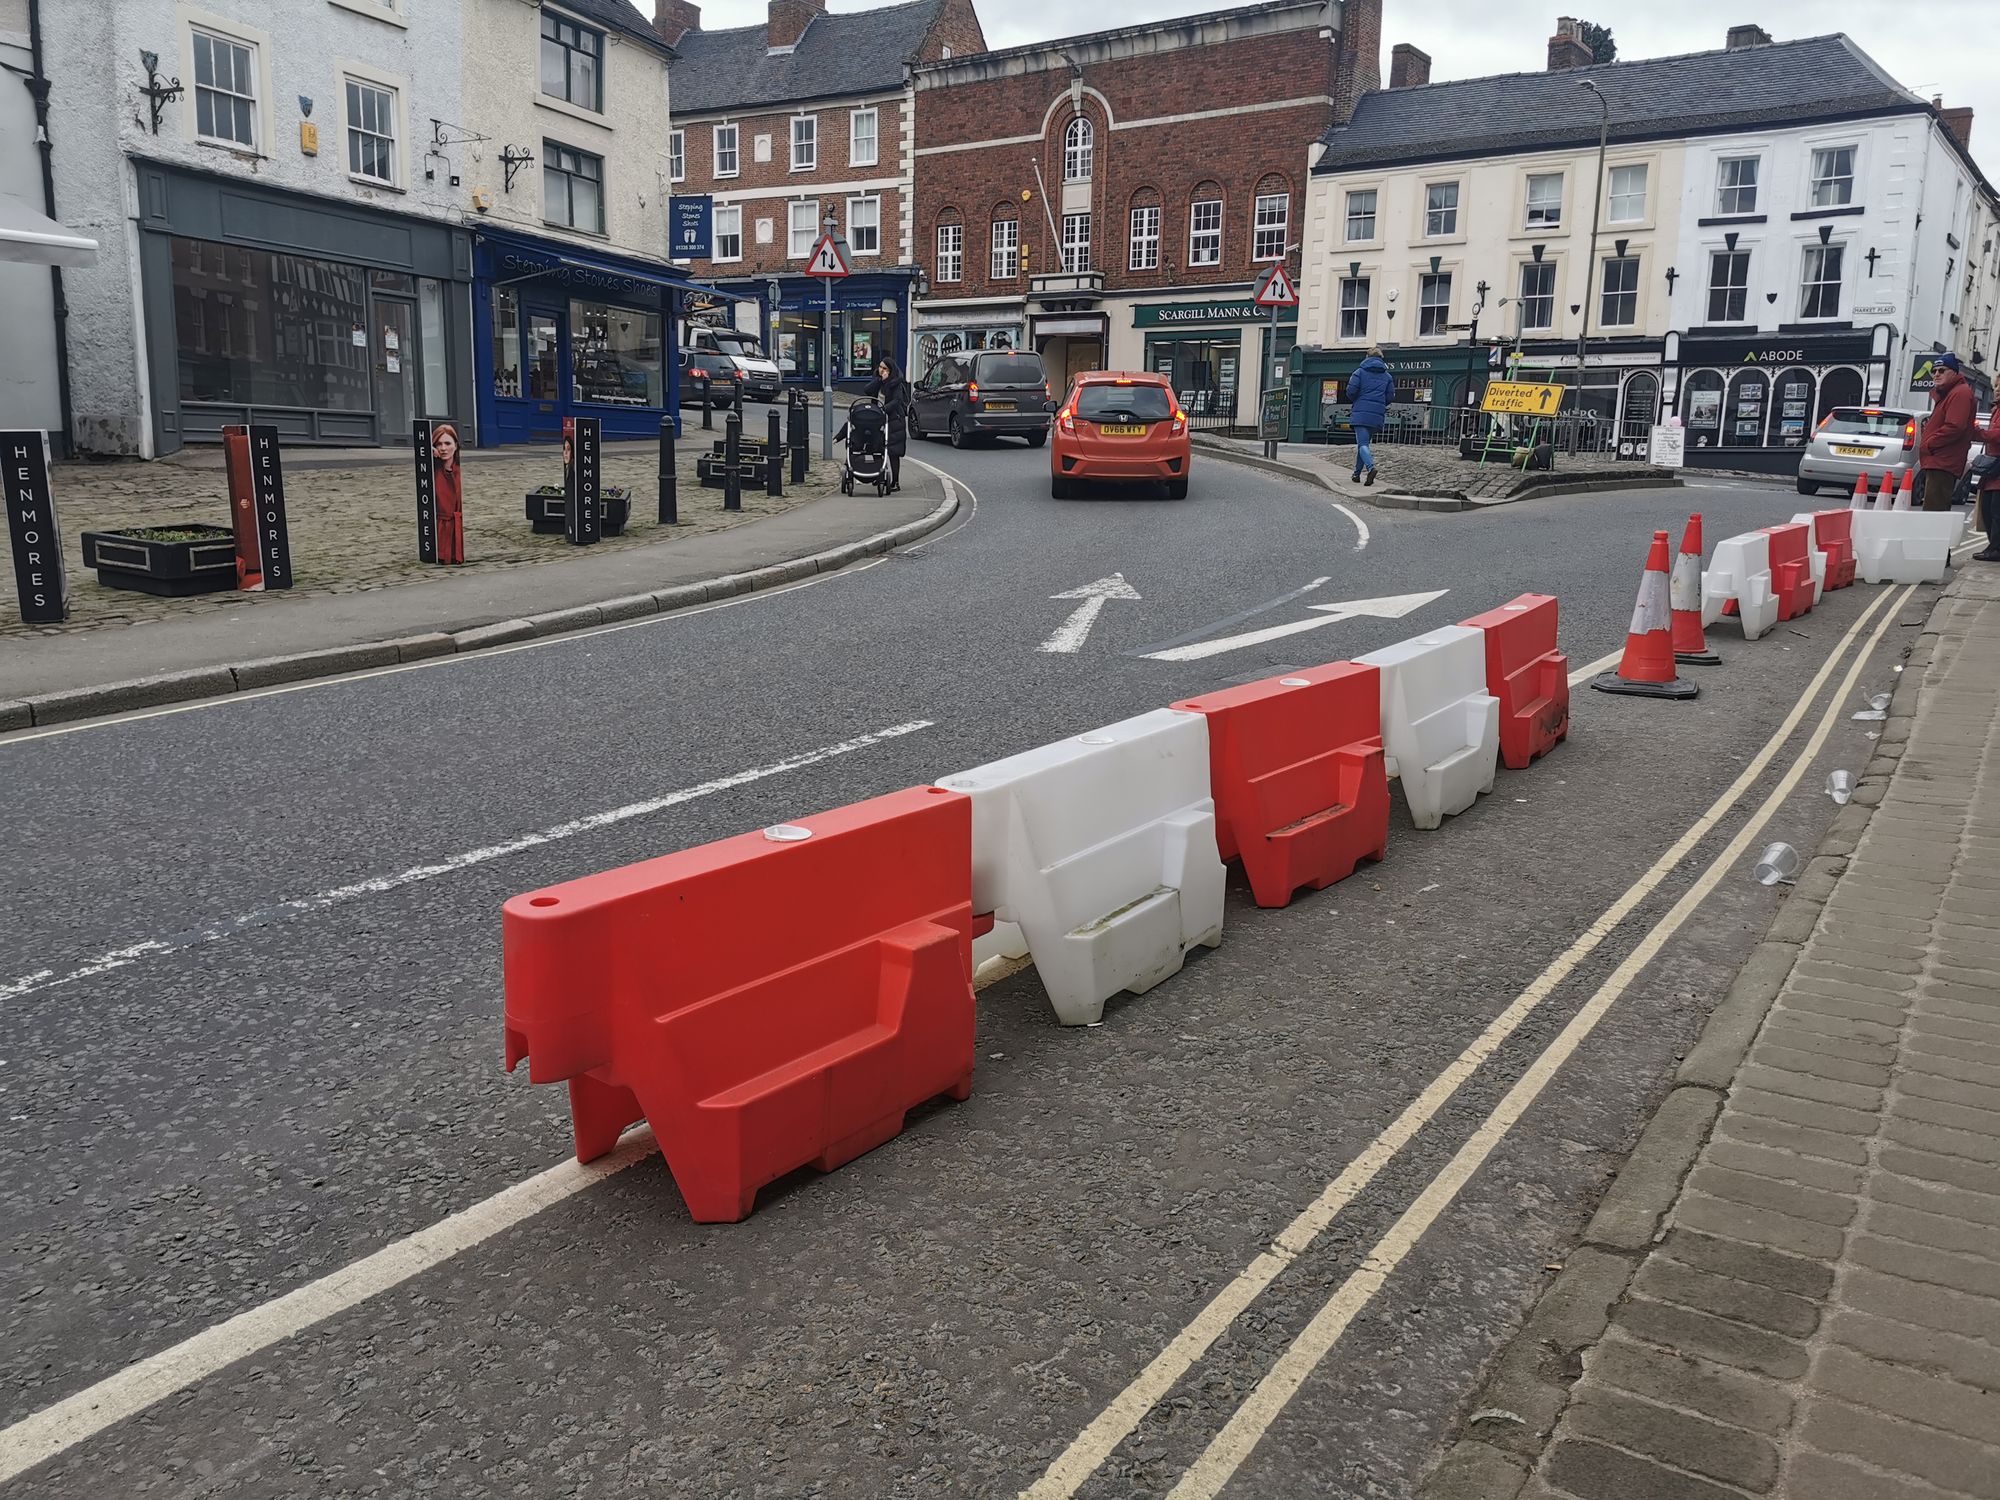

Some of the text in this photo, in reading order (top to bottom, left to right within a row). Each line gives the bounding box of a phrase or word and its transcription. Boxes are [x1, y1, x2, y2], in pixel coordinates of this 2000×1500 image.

[678, 203, 703, 212] Stepping
[502, 254, 658, 297] Stepping Stones Shoes
[1158, 308, 1206, 321] SCARGILL
[1207, 305, 1241, 318] MANN
[1242, 306, 1251, 317] &
[1758, 350, 1803, 361] ABODE
[1400, 361, 1431, 370] VAULTS
[1489, 387, 1534, 398] Diverted
[1491, 398, 1524, 408] traffic
[583, 428, 592, 533] HENMORES
[418, 431, 431, 552] HENMORES
[260, 438, 281, 577] HENMORES
[14, 446, 46, 607] HENMORES
